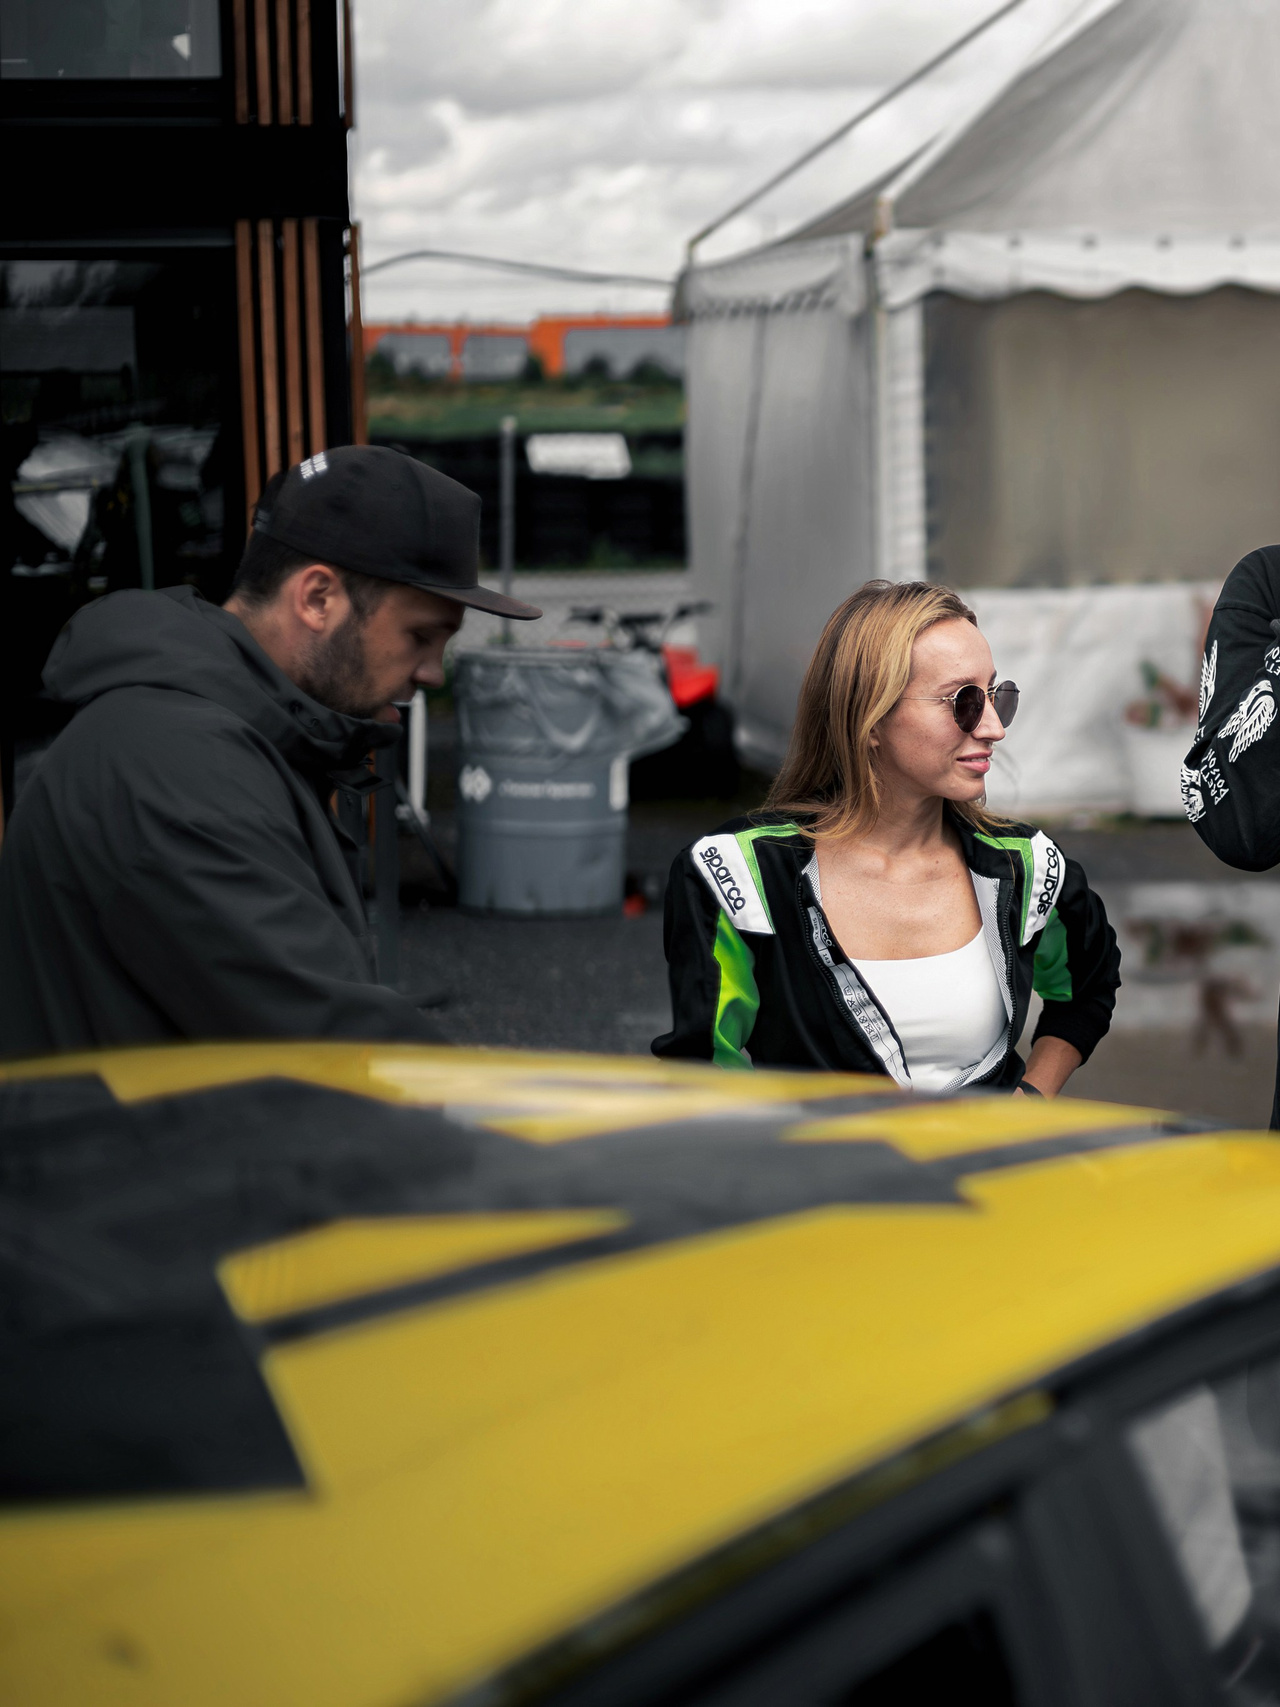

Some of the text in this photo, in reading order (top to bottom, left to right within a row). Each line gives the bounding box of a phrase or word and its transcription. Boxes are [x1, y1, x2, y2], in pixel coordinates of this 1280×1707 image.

[1201, 761, 1222, 806] PRETT
[699, 846, 746, 916] sparco
[1037, 846, 1060, 916] sparco
